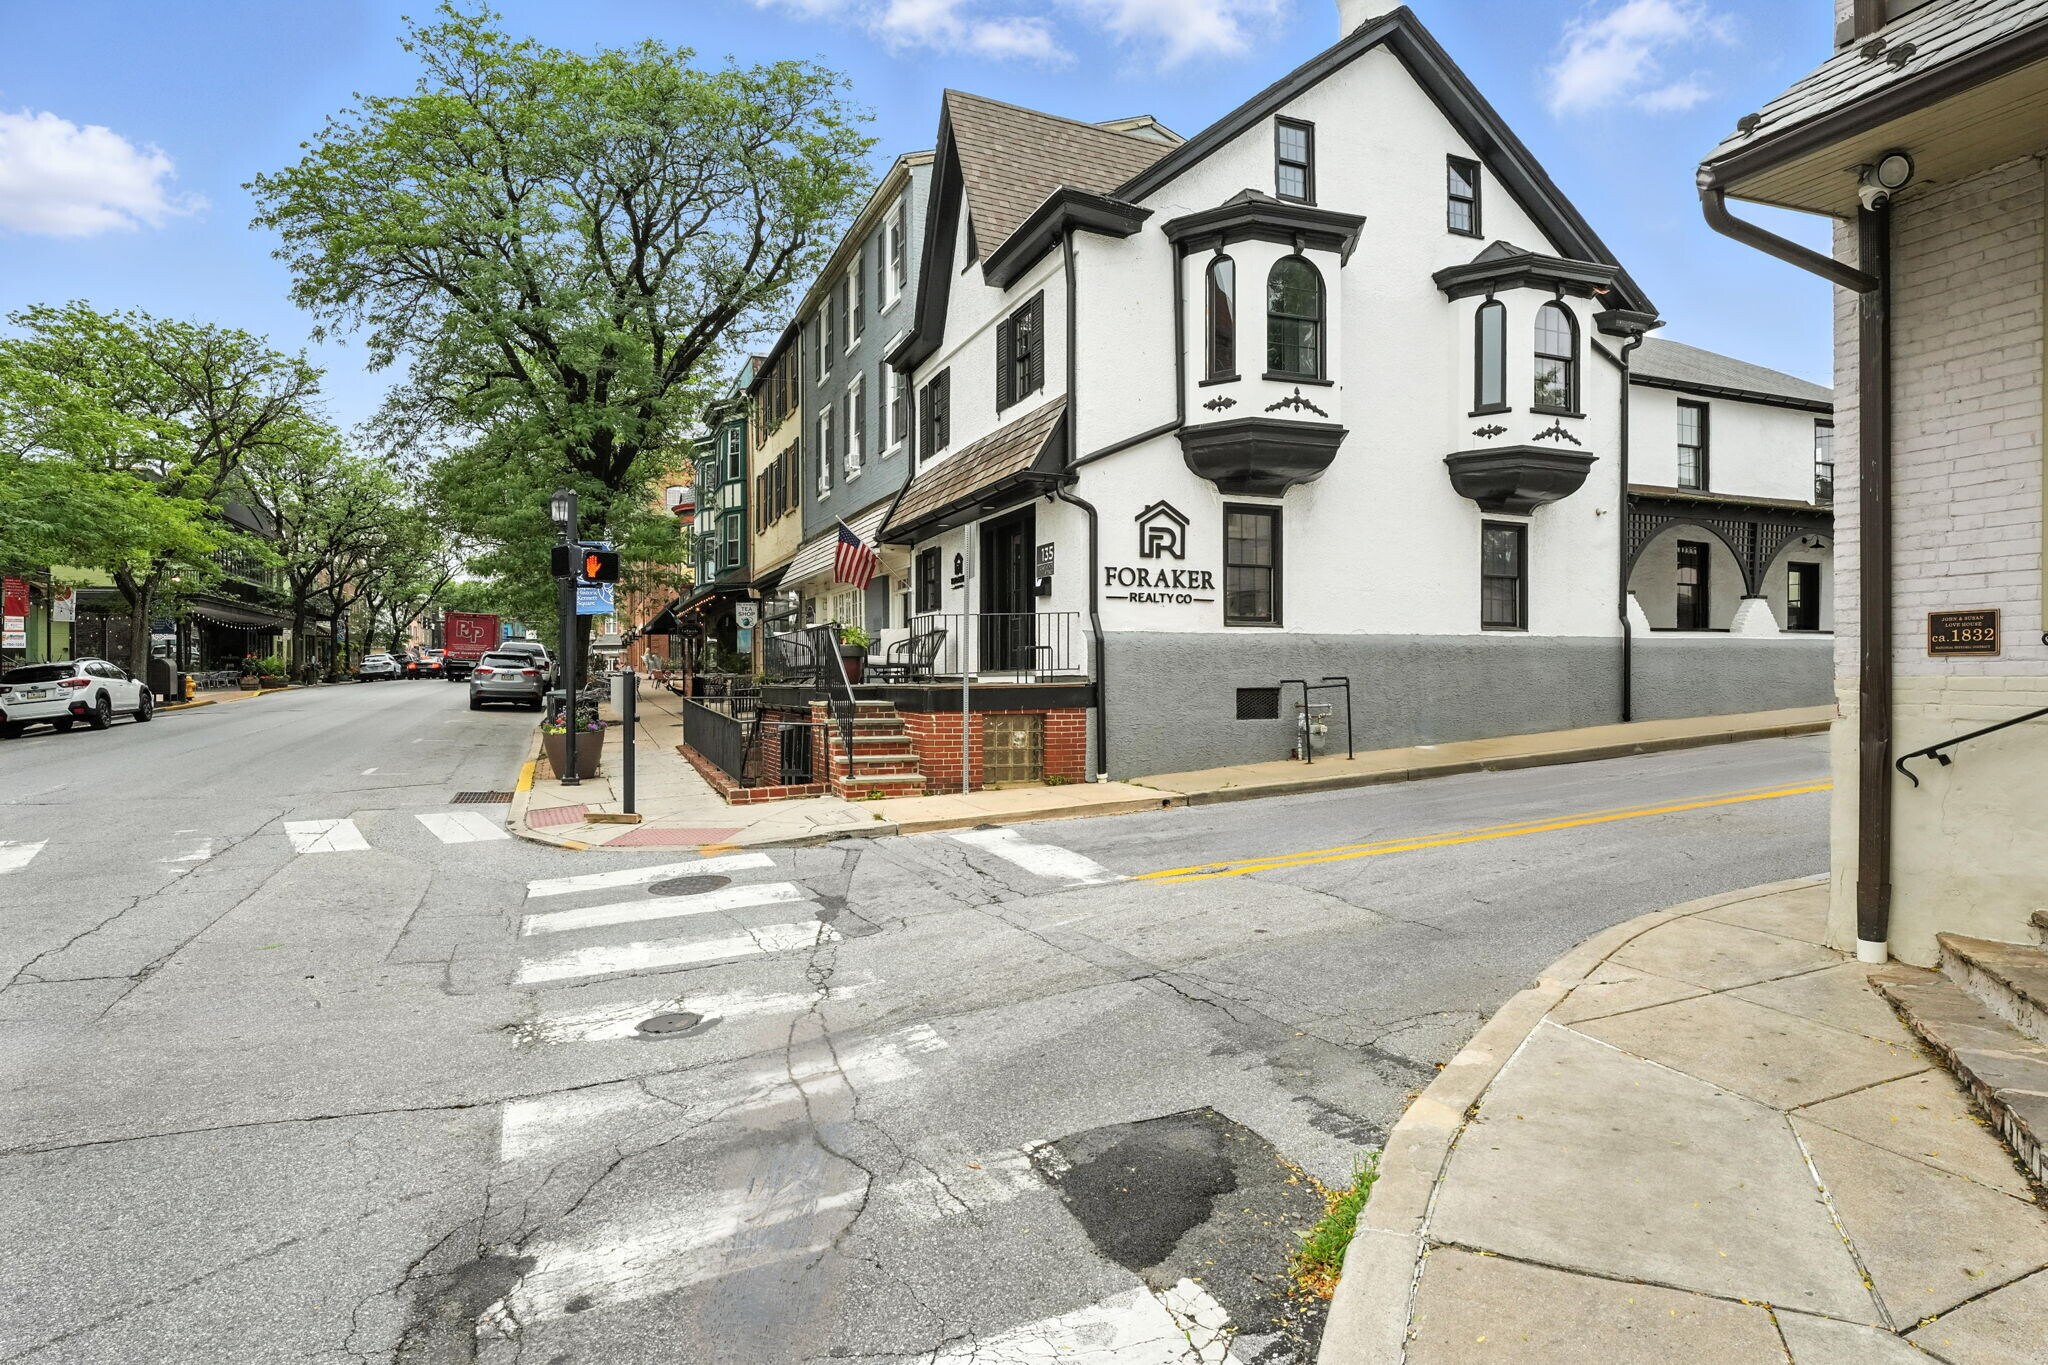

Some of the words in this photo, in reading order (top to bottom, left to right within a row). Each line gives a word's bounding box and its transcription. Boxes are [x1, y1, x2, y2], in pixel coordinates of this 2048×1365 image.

[1041, 545, 1054, 562] 135
[1104, 566, 1216, 590] FORAKER
[1129, 592, 1174, 603] REALTY
[1175, 594, 1192, 604] CO
[1932, 628, 1994, 643] ca.1832
